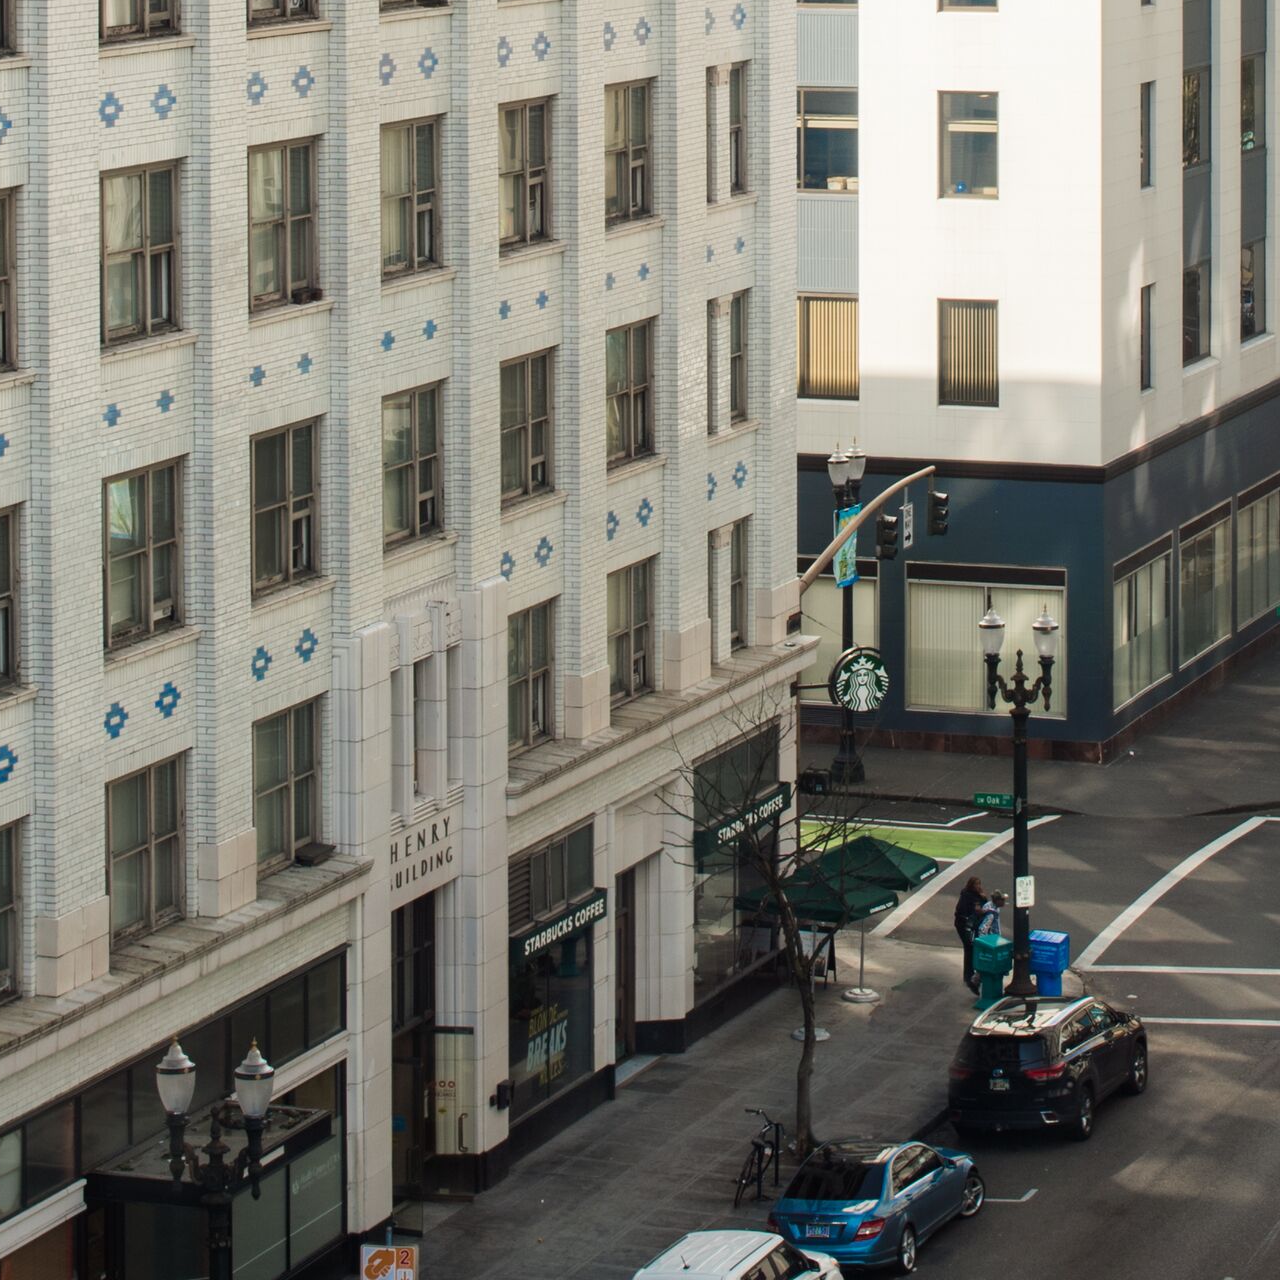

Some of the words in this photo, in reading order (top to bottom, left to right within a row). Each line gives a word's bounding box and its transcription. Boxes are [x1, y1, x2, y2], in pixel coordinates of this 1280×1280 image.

[986, 795, 1000, 805] Oak
[390, 816, 450, 865] HENRY
[390, 846, 453, 892] UILDING
[524, 916, 573, 956] STARBUCKS
[574, 898, 604, 928] COFFEE
[526, 1019, 568, 1073] BREAKS
[400, 1250, 410, 1265] 2
